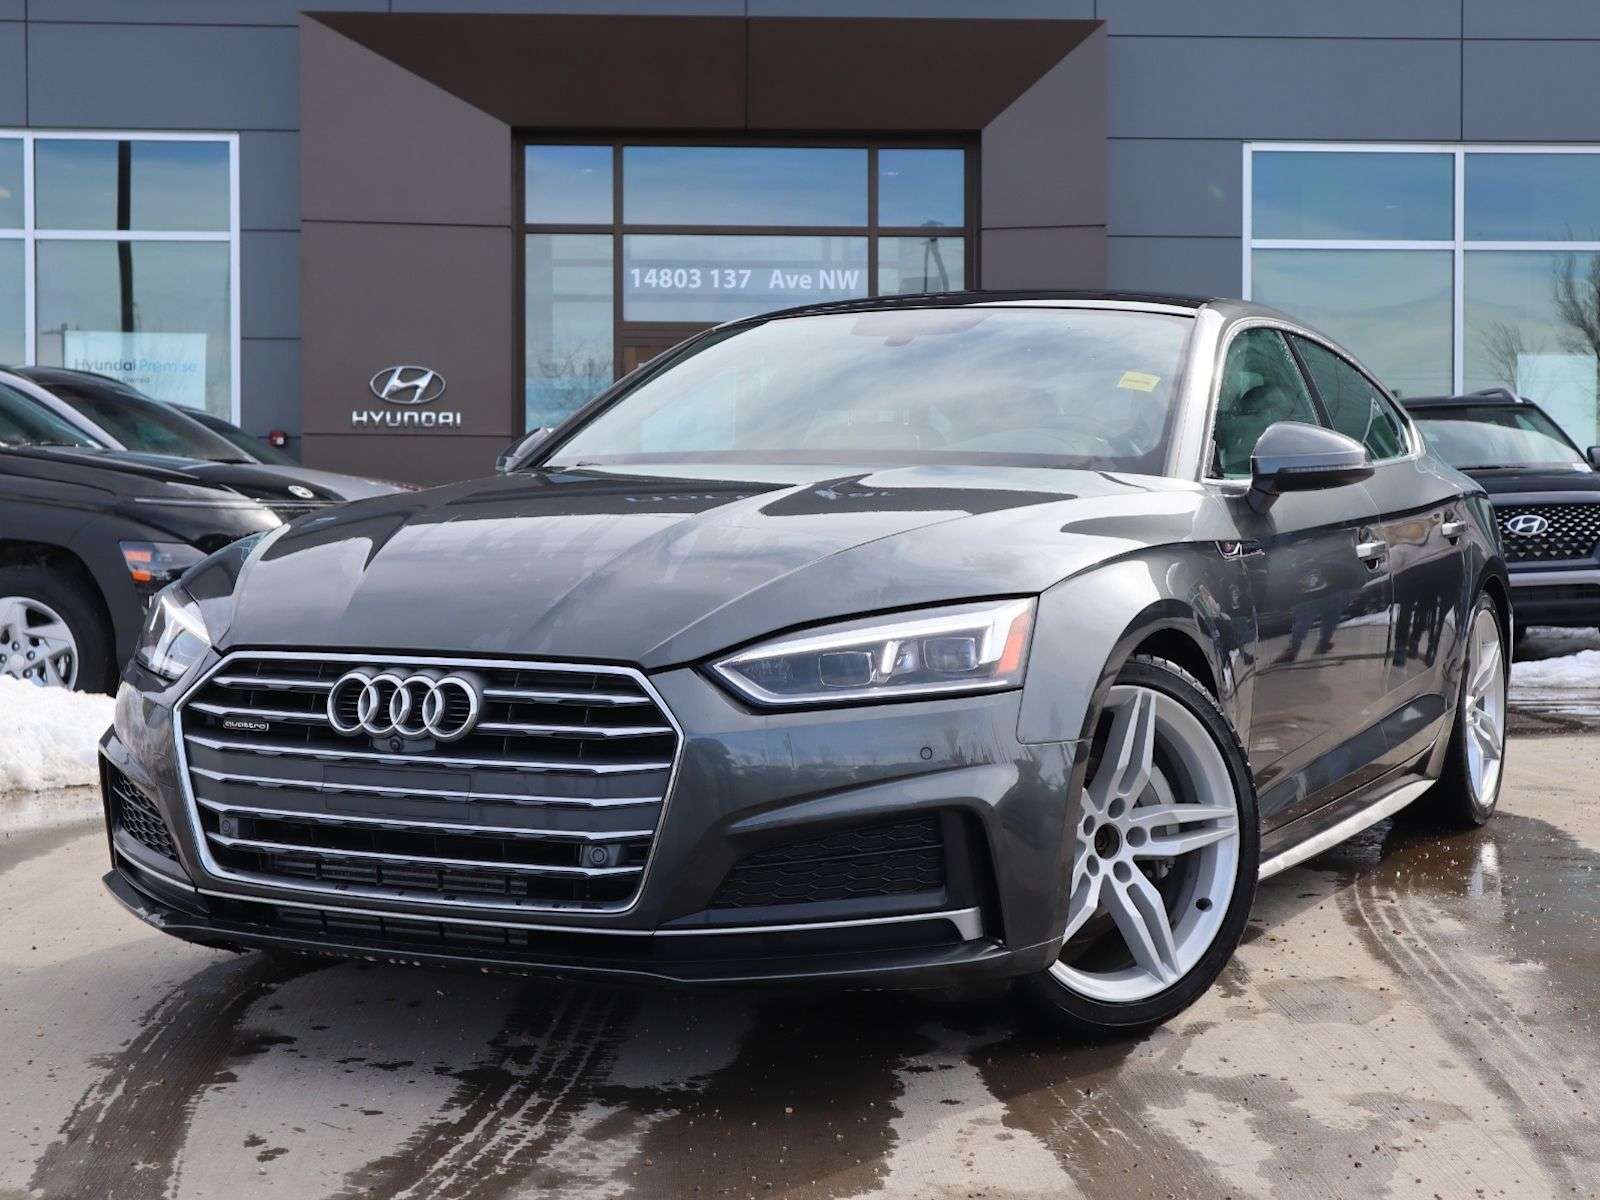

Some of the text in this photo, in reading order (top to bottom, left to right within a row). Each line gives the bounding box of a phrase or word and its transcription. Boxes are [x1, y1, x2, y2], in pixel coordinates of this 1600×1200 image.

[631, 268, 860, 290] 14803 137 Ave NW
[74, 358, 136, 372] Hyundai
[351, 411, 462, 427] HYUNDAI
[224, 721, 266, 730] quattro
